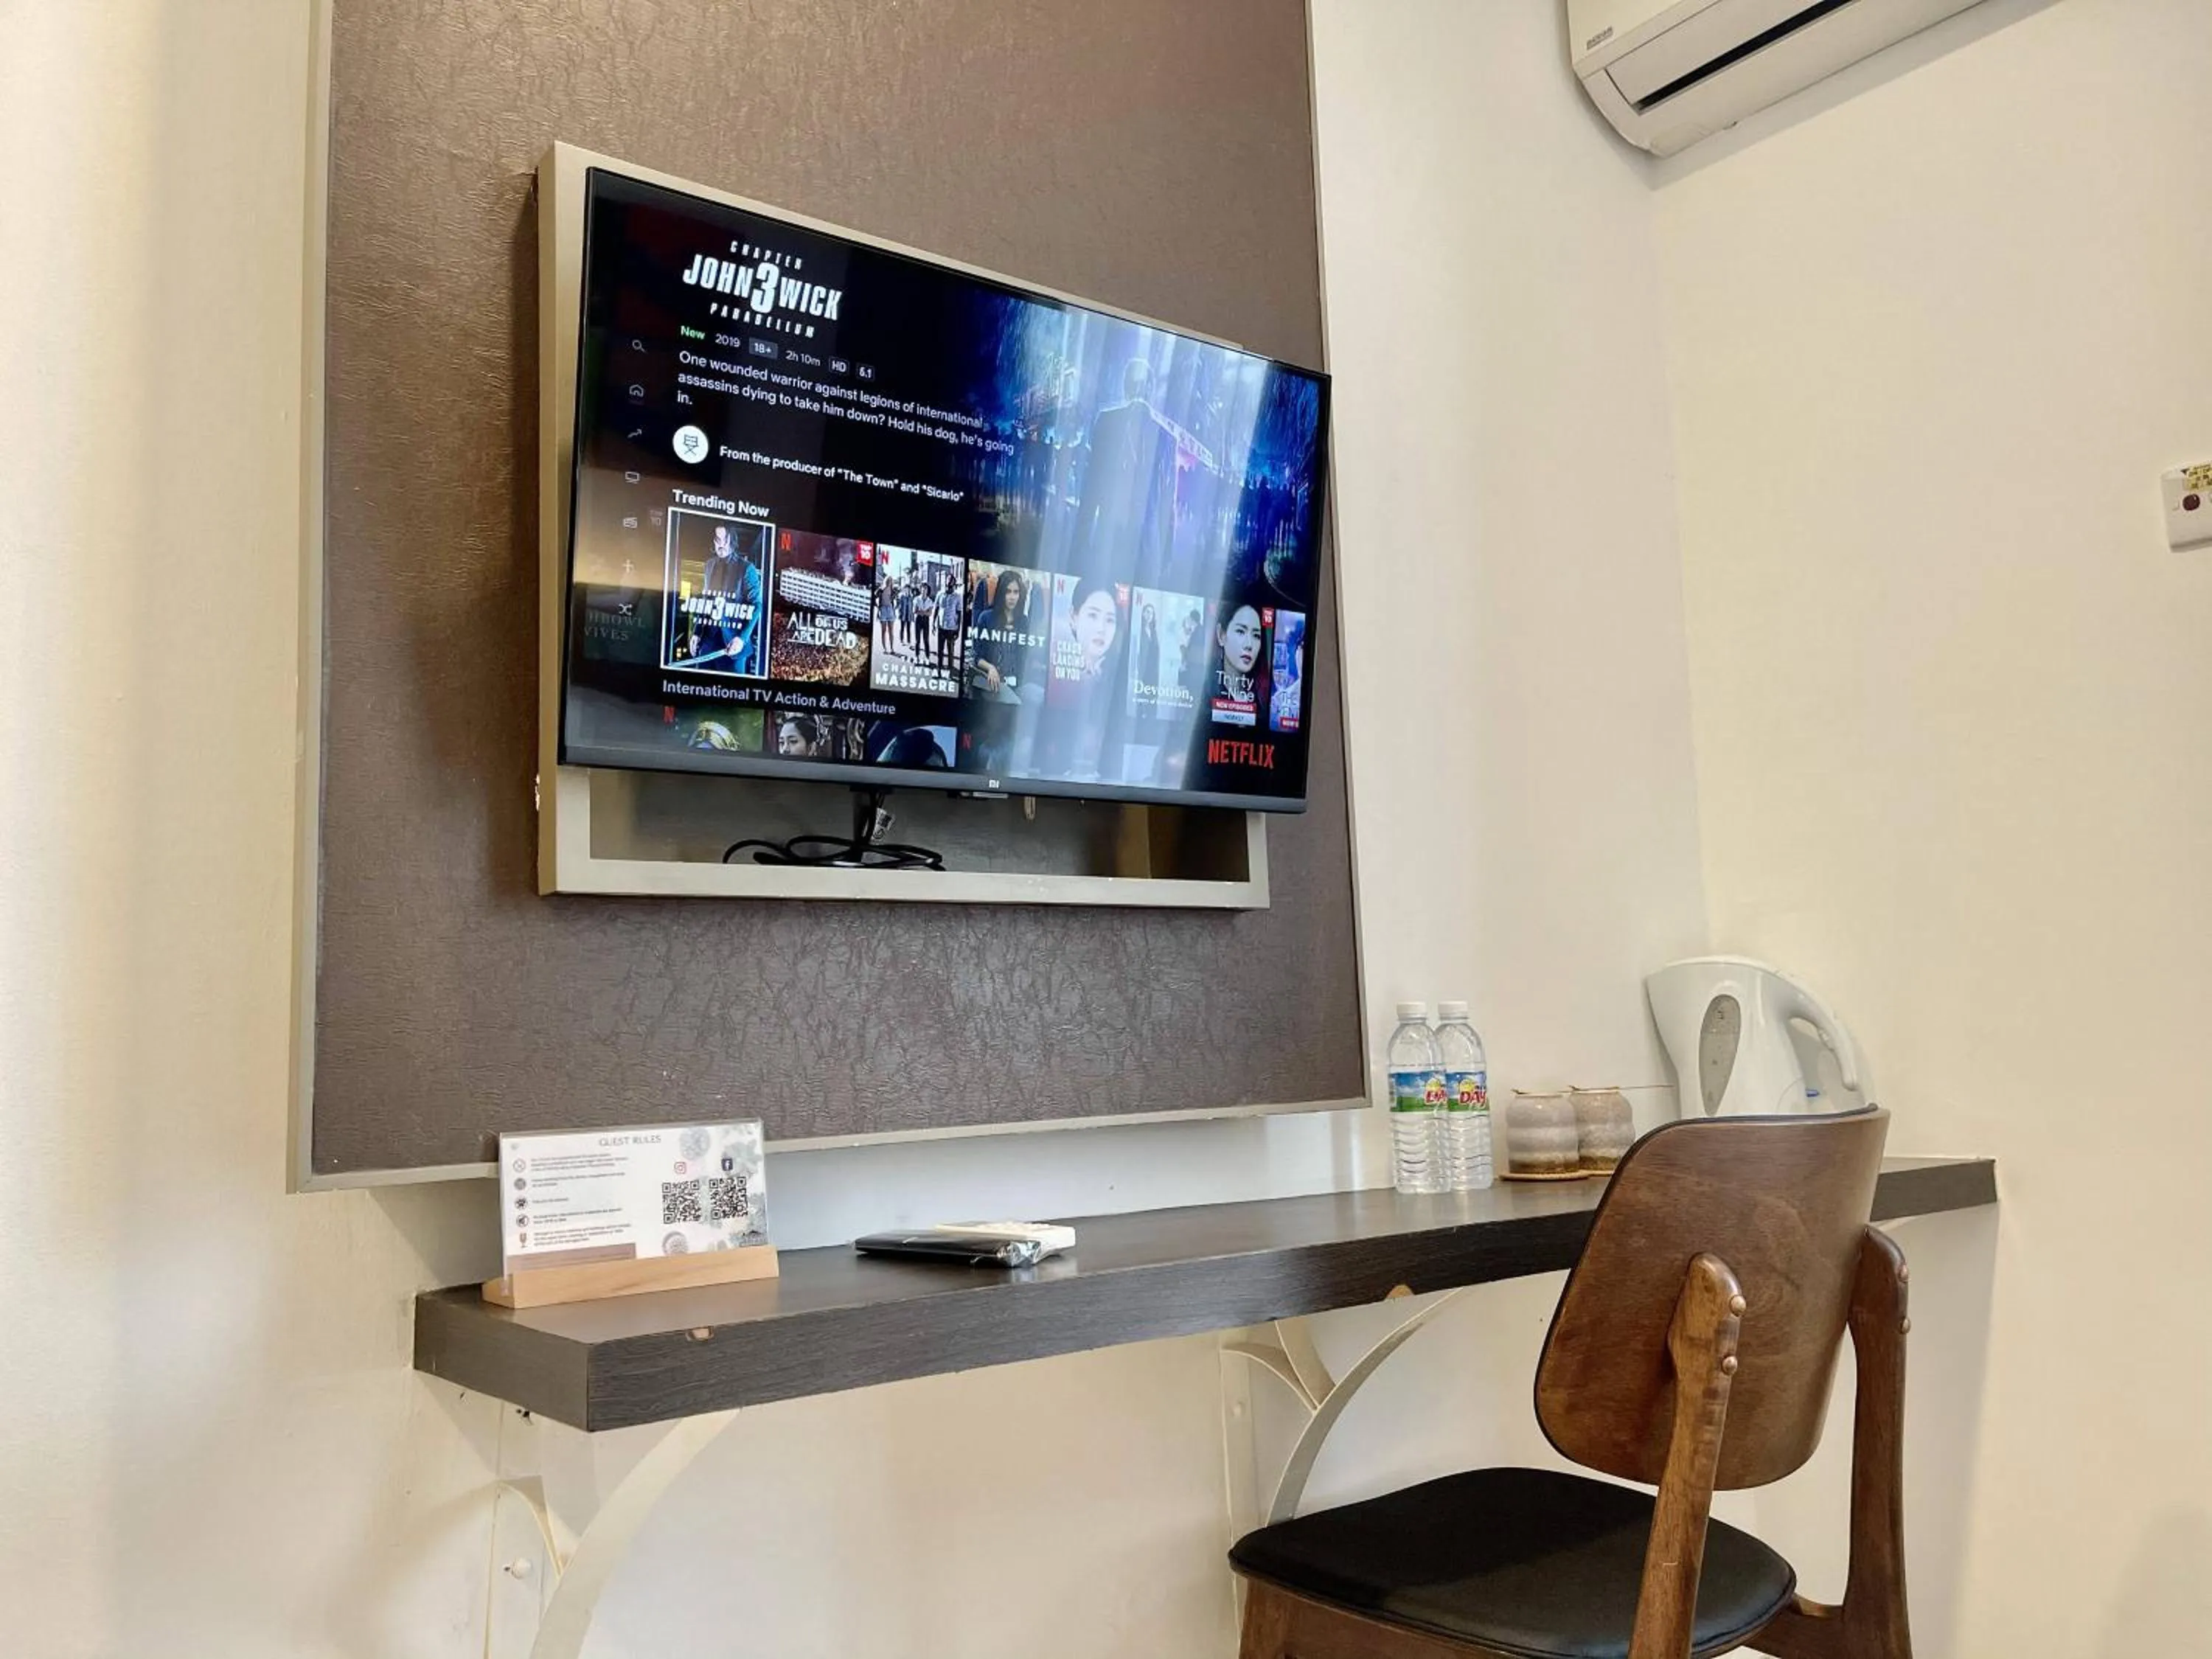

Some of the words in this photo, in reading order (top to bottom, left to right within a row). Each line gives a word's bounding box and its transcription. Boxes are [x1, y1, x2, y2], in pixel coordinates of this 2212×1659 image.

[730, 240, 802, 270] CHAPTER
[682, 254, 754, 298] JOHN
[750, 262, 779, 313] 3
[779, 276, 842, 321] WICK
[710, 302, 815, 338] PARABELLUM
[681, 325, 706, 340] New
[715, 333, 741, 348] 2019
[754, 342, 772, 354] 18+
[785, 350, 799, 361] 2h
[801, 353, 821, 366] 10m
[831, 360, 846, 372] HD
[677, 390, 693, 405] in.
[679, 350, 707, 367] One
[709, 358, 768, 381] wounded
[771, 372, 813, 390] warrior
[815, 381, 858, 401] against
[860, 391, 900, 410] legions
[902, 403, 915, 413] of
[917, 404, 984, 428] international
[678, 372, 740, 394] assassins
[742, 385, 776, 405] dying
[779, 393, 792, 406] to
[794, 397, 820, 412] take
[822, 402, 844, 418] him
[847, 407, 886, 426] down?
[888, 416, 914, 432] Hold
[917, 422, 933, 437] his
[934, 427, 959, 444] dog,
[961, 431, 983, 448] he's
[984, 439, 1015, 456] going
[720, 445, 750, 462] From
[752, 451, 771, 465] the
[772, 457, 822, 476] producer
[824, 466, 835, 478] of
[900, 480, 919, 494] and
[672, 488, 734, 515] Trending
[738, 501, 770, 518] Now
[725, 602, 755, 620] WICK
[787, 611, 815, 631] ALL
[815, 628, 857, 649] DEAD
[967, 627, 1046, 647] MANIFEST
[663, 680, 749, 701] International
[753, 689, 772, 702] TV
[774, 692, 816, 708] Action
[819, 696, 830, 709] &
[832, 697, 896, 714] Adventure
[875, 672, 955, 692] MASSACRE
[1208, 739, 1275, 769] NETFLIX
